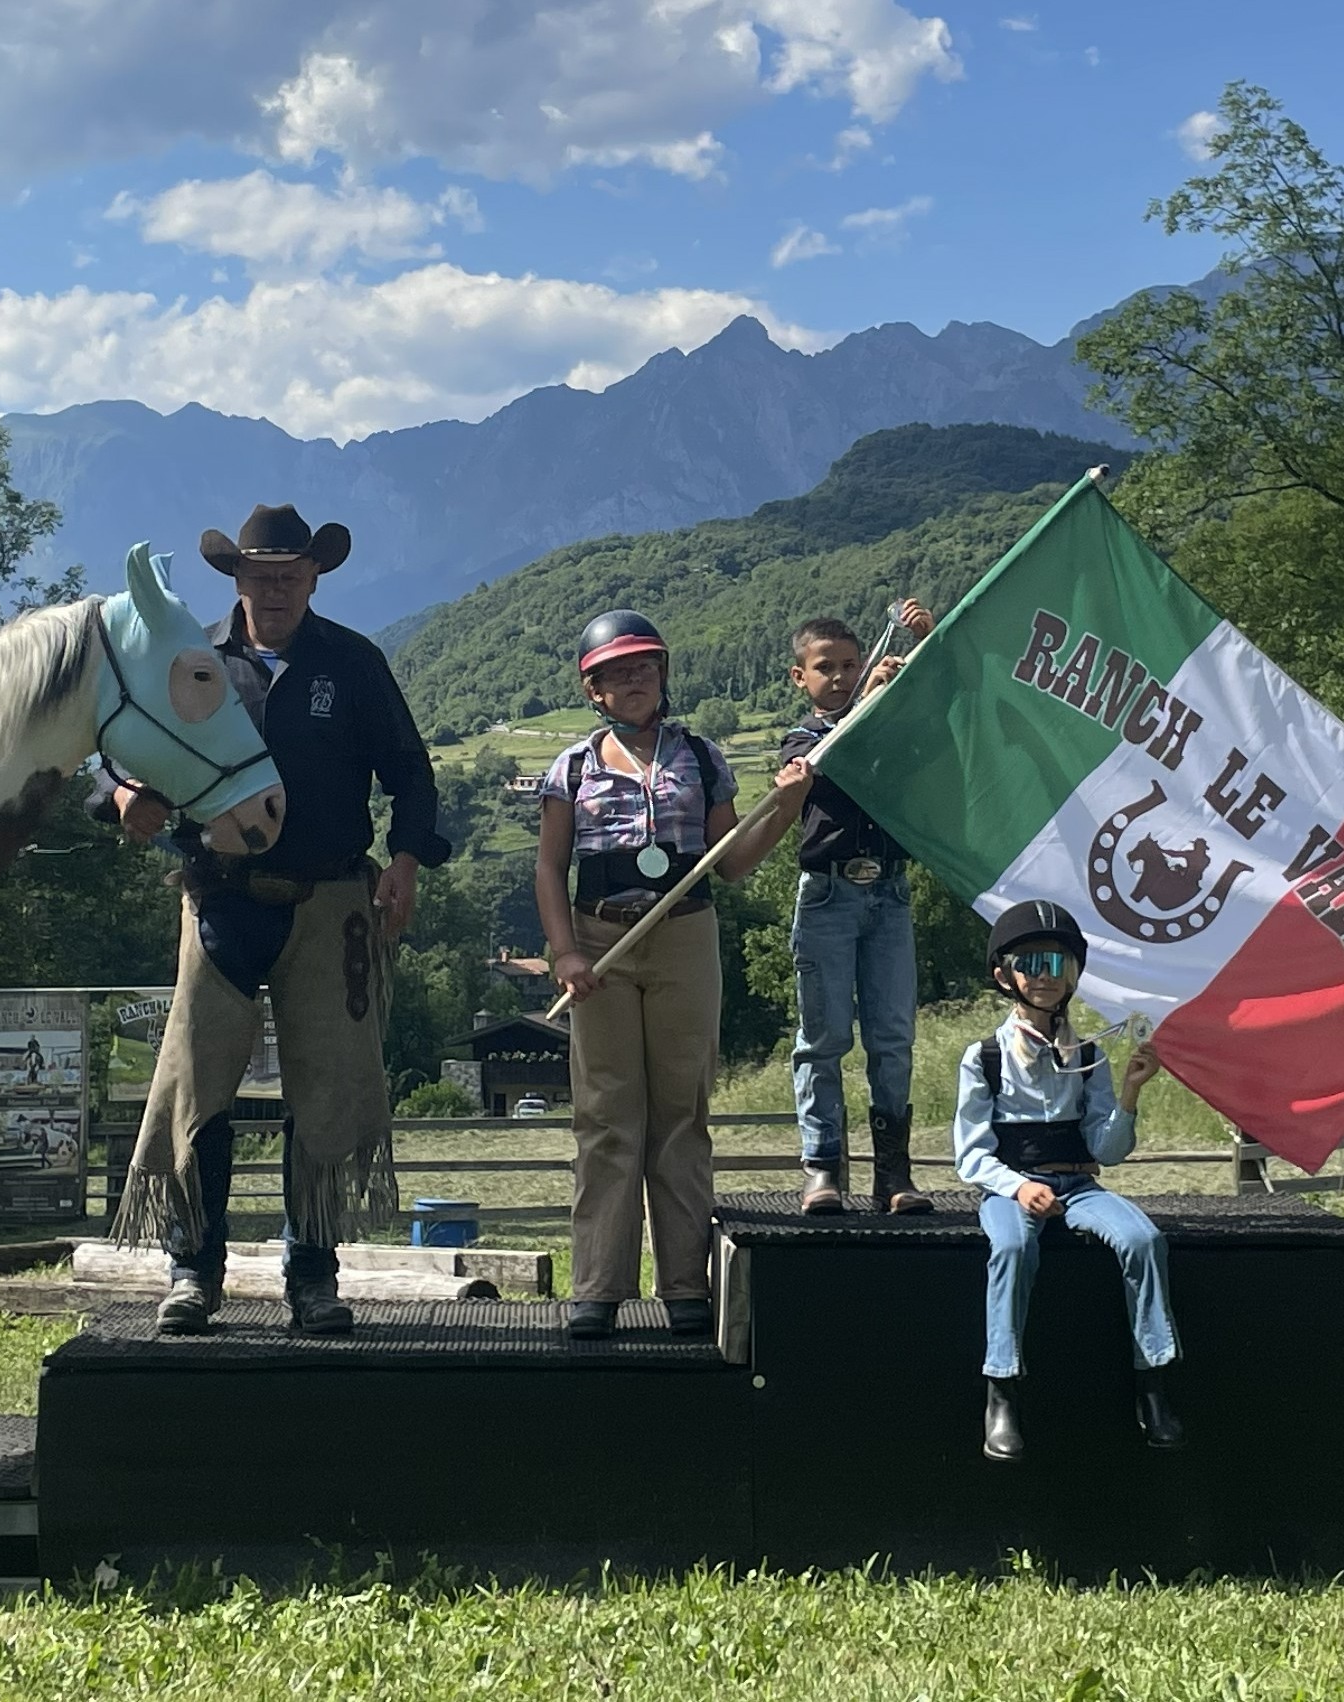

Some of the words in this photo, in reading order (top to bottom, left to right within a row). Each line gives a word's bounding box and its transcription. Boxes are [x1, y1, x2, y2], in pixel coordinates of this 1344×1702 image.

[1011, 608, 1203, 771] RANCH
[1203, 747, 1287, 840] LE
[117, 1000, 158, 1024] RANCH
